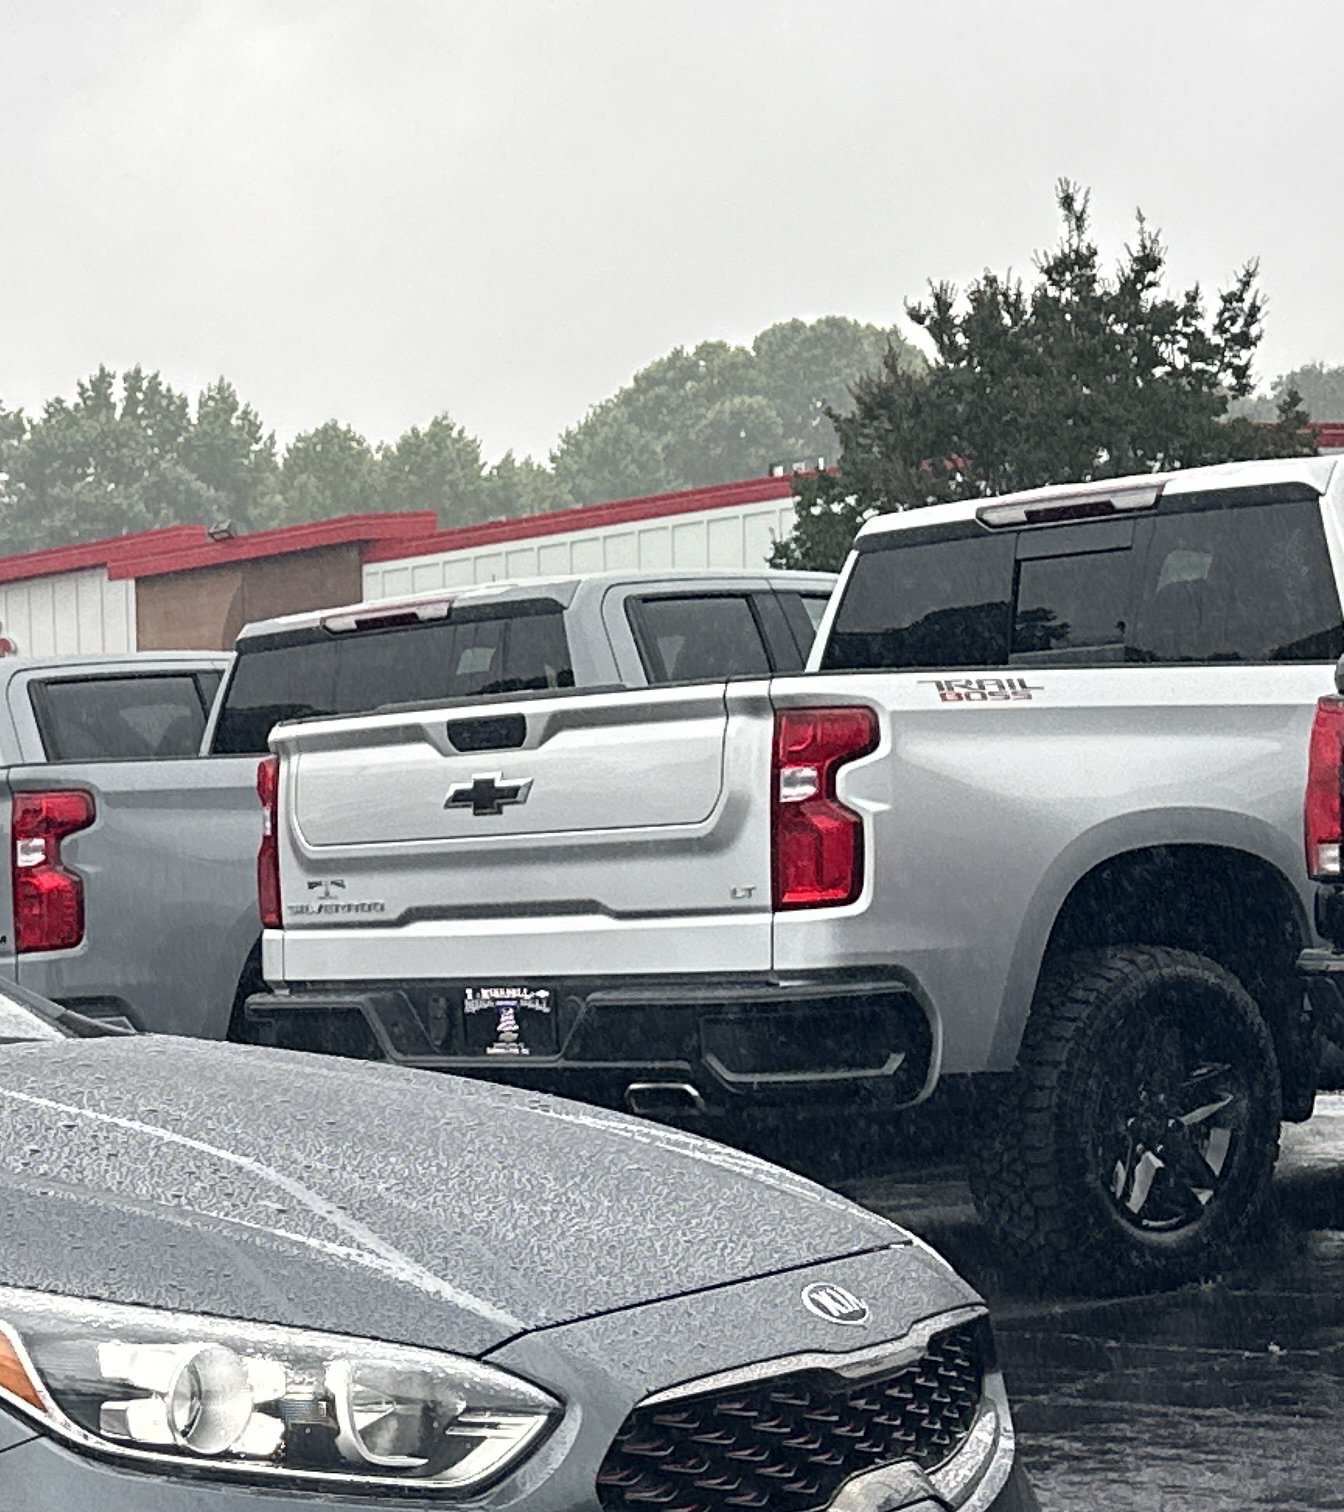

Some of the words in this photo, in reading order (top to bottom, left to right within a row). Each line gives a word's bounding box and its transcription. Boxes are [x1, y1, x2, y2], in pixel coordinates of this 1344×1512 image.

[917, 678, 1044, 692] TRAIL
[939, 690, 1032, 702] BOSS
[731, 885, 756, 899] LT
